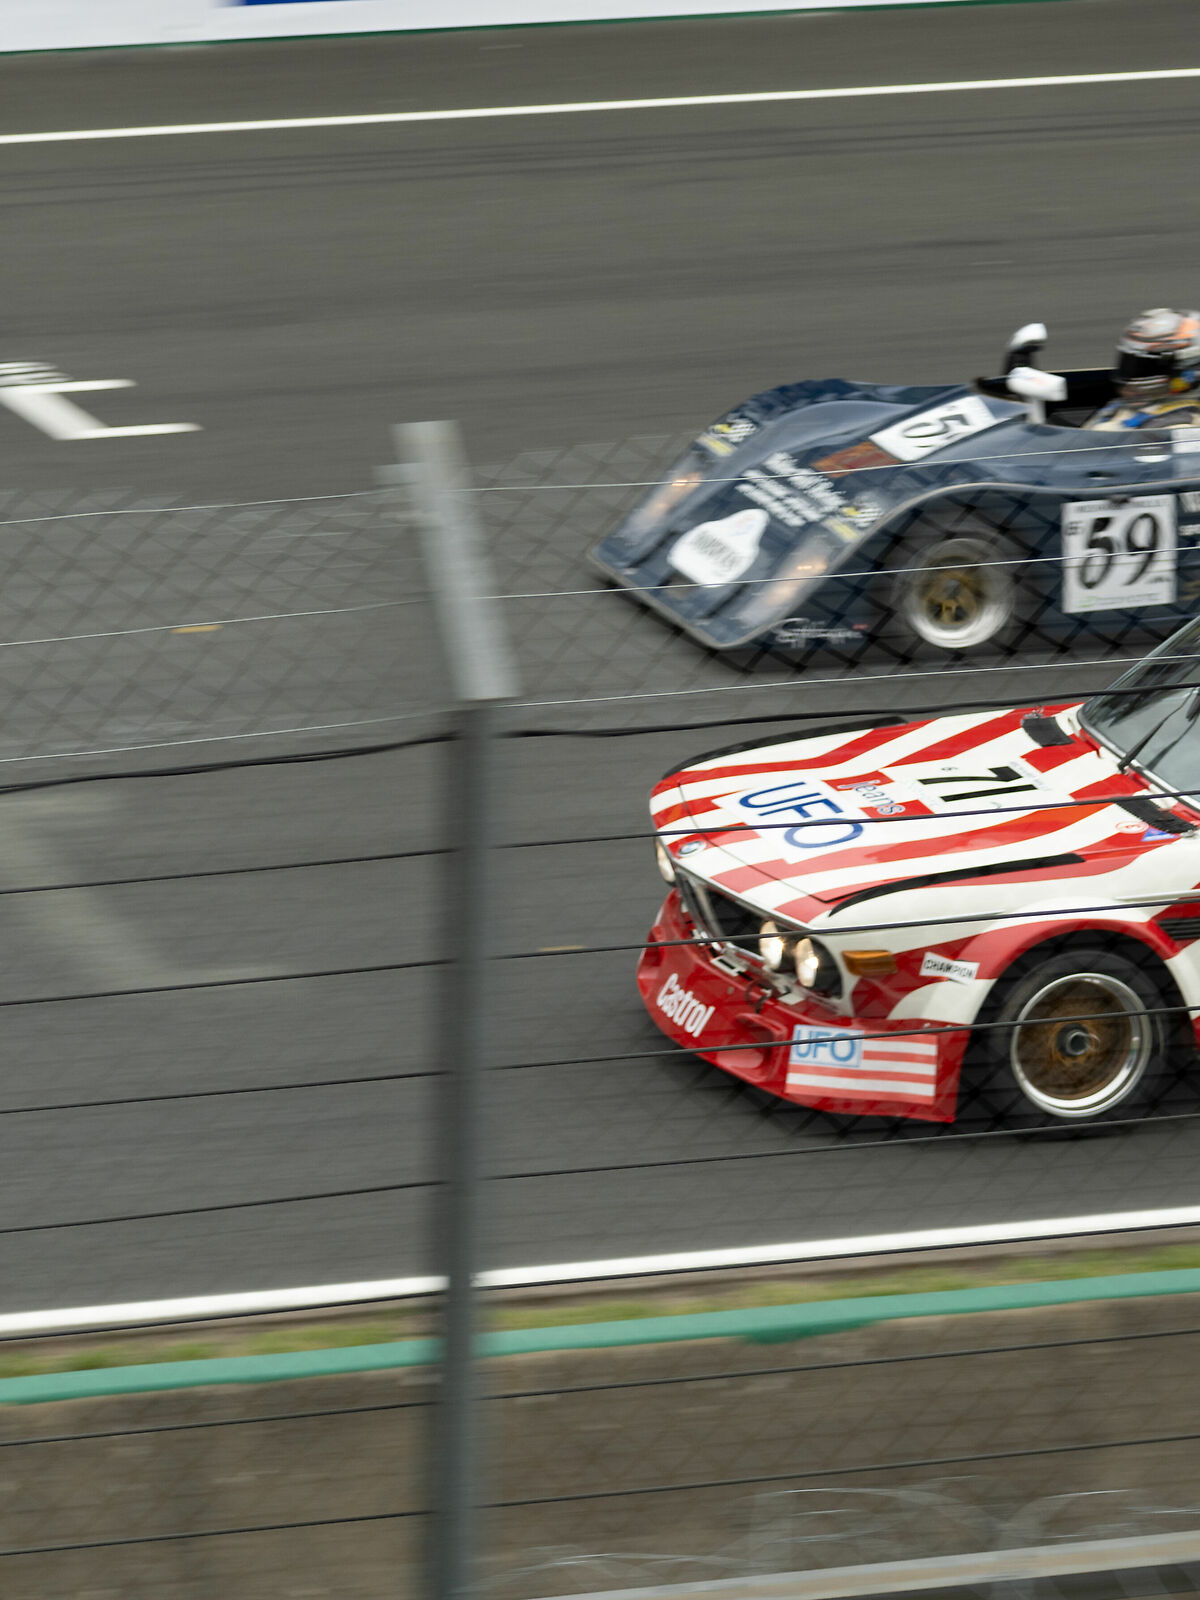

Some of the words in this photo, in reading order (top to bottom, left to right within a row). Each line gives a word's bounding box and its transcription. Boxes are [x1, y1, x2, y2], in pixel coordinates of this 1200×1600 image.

[1079, 512, 1160, 590] 59
[837, 778, 905, 817] jeans
[917, 765, 1038, 803] 71
[738, 781, 863, 849] UFO
[924, 959, 976, 979] CHAMPION
[656, 972, 716, 1038] Castrol
[792, 1026, 858, 1063] UFO
